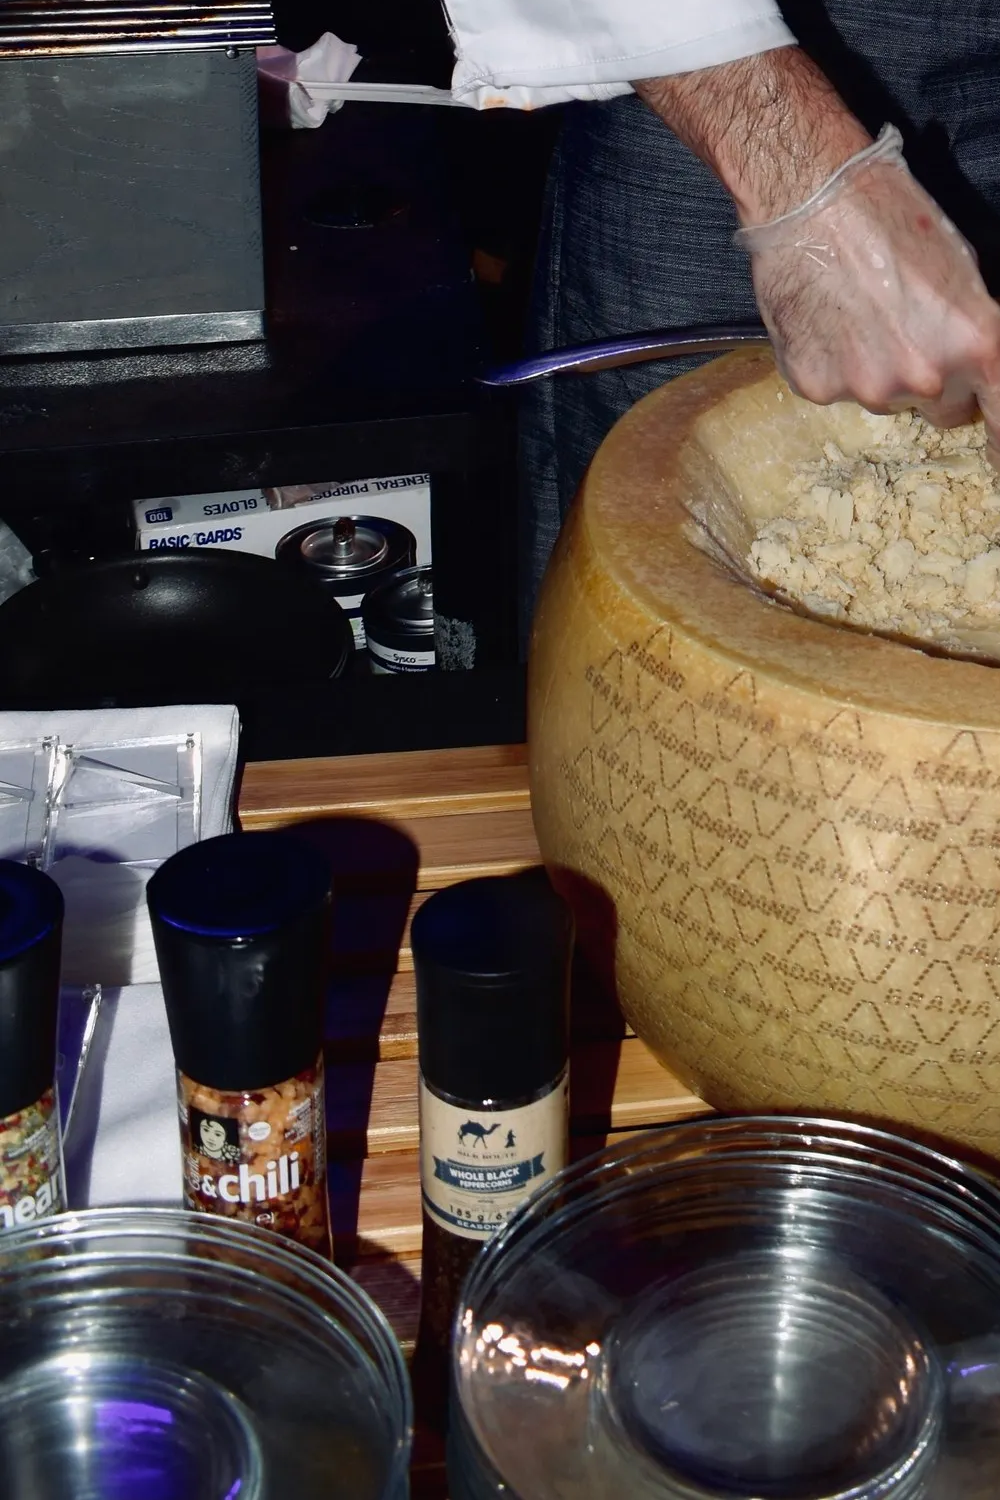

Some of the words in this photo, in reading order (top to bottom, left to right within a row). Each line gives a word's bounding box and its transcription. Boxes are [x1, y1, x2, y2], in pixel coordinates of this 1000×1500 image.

[307, 481, 368, 501] PURPOS
[203, 497, 257, 516] GLOVES
[149, 511, 169, 522] 100
[149, 534, 190, 550] BASIC
[196, 527, 242, 546] GARDS
[202, 1174, 217, 1198] &
[218, 1151, 300, 1203] chili
[449, 1168, 485, 1181] WHOLE
[486, 1167, 520, 1181] BLACK
